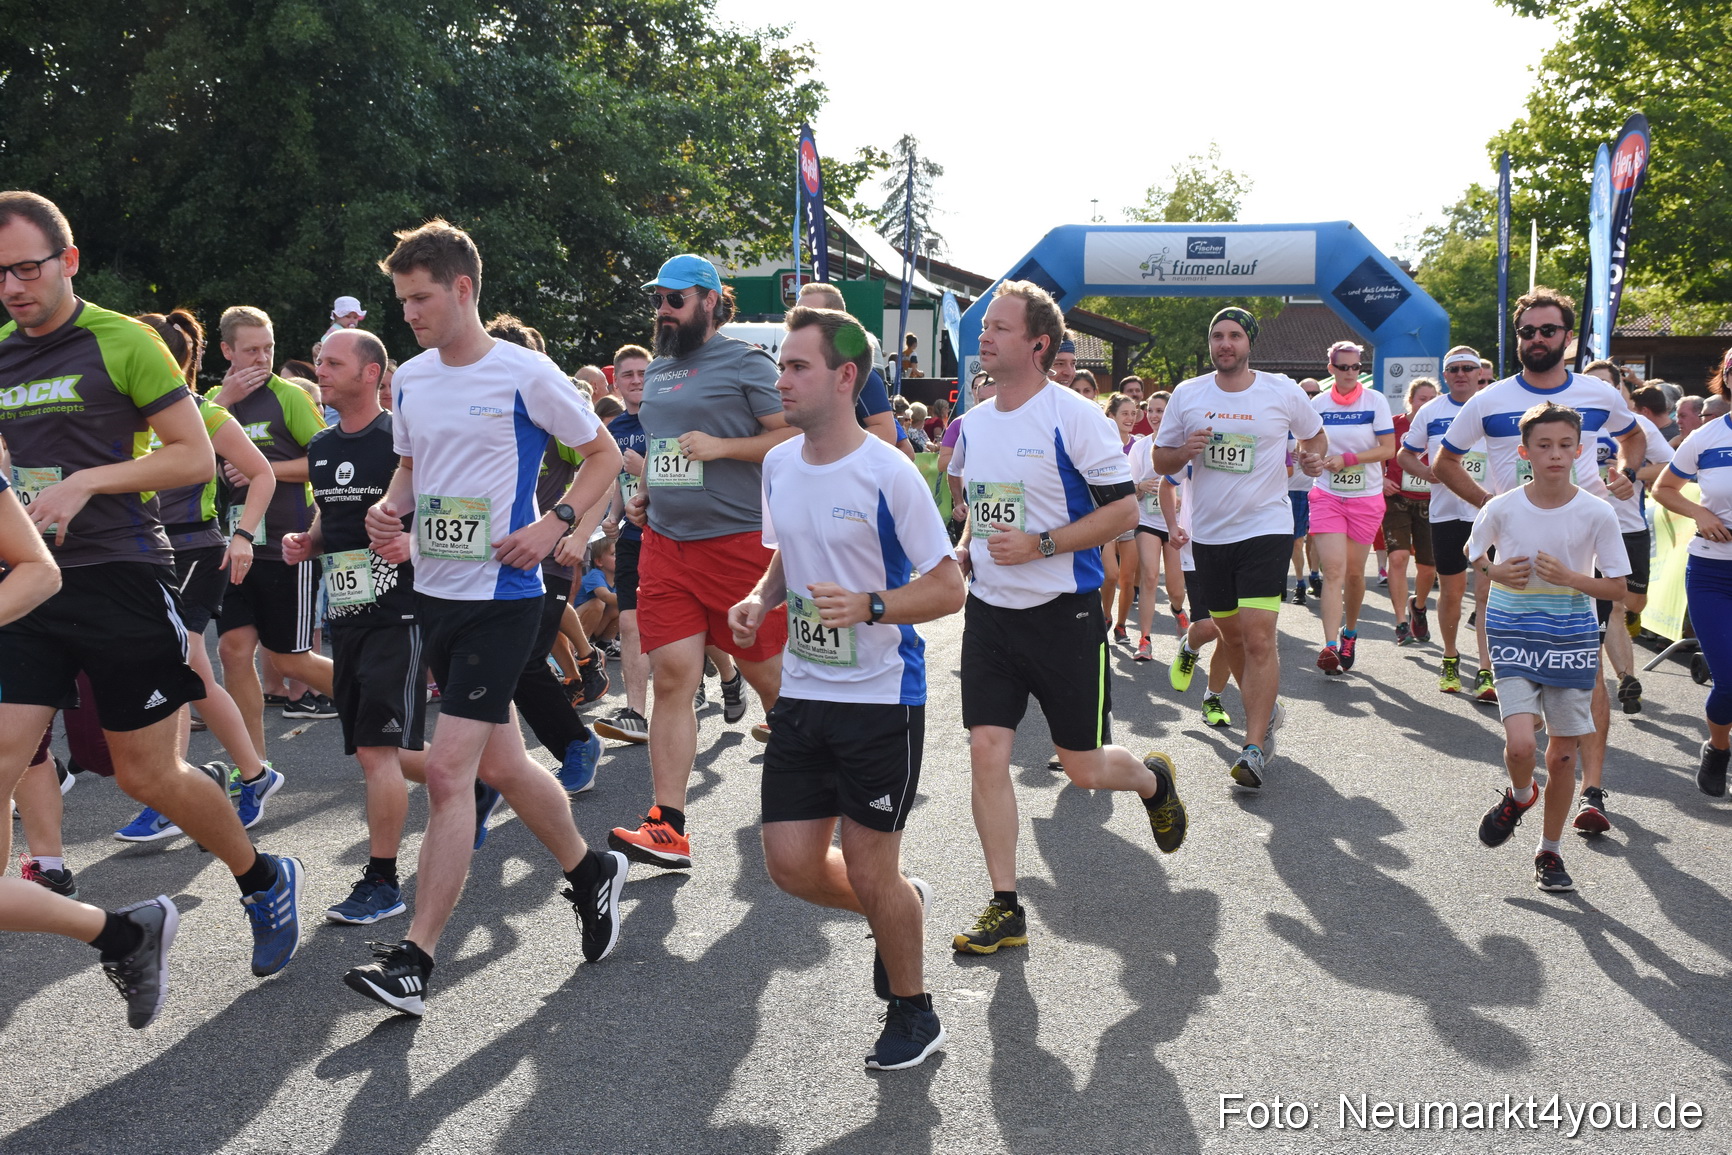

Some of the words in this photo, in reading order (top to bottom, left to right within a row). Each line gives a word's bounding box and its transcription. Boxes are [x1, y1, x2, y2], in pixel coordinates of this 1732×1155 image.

[1194, 241, 1224, 252] Fischer
[1172, 259, 1259, 275] firmenlauf
[19, 407, 41, 417] smart
[42, 404, 85, 413] concepts
[481, 406, 503, 414] PETTER
[1218, 413, 1256, 421] KLEBL
[1208, 445, 1246, 463] 1191
[653, 455, 691, 473] 1317
[1333, 473, 1361, 485] 2429
[845, 509, 869, 520] PETTER
[974, 501, 1016, 523] 1845
[424, 517, 480, 543] 1837
[449, 542, 469, 550] Moritz
[329, 570, 358, 592] 105
[792, 616, 840, 648] 1841
[811, 645, 838, 655] Matthias
[1490, 644, 1597, 671] CONVERSE
[143, 697, 168, 710] adidas
[869, 801, 893, 813] adidas
